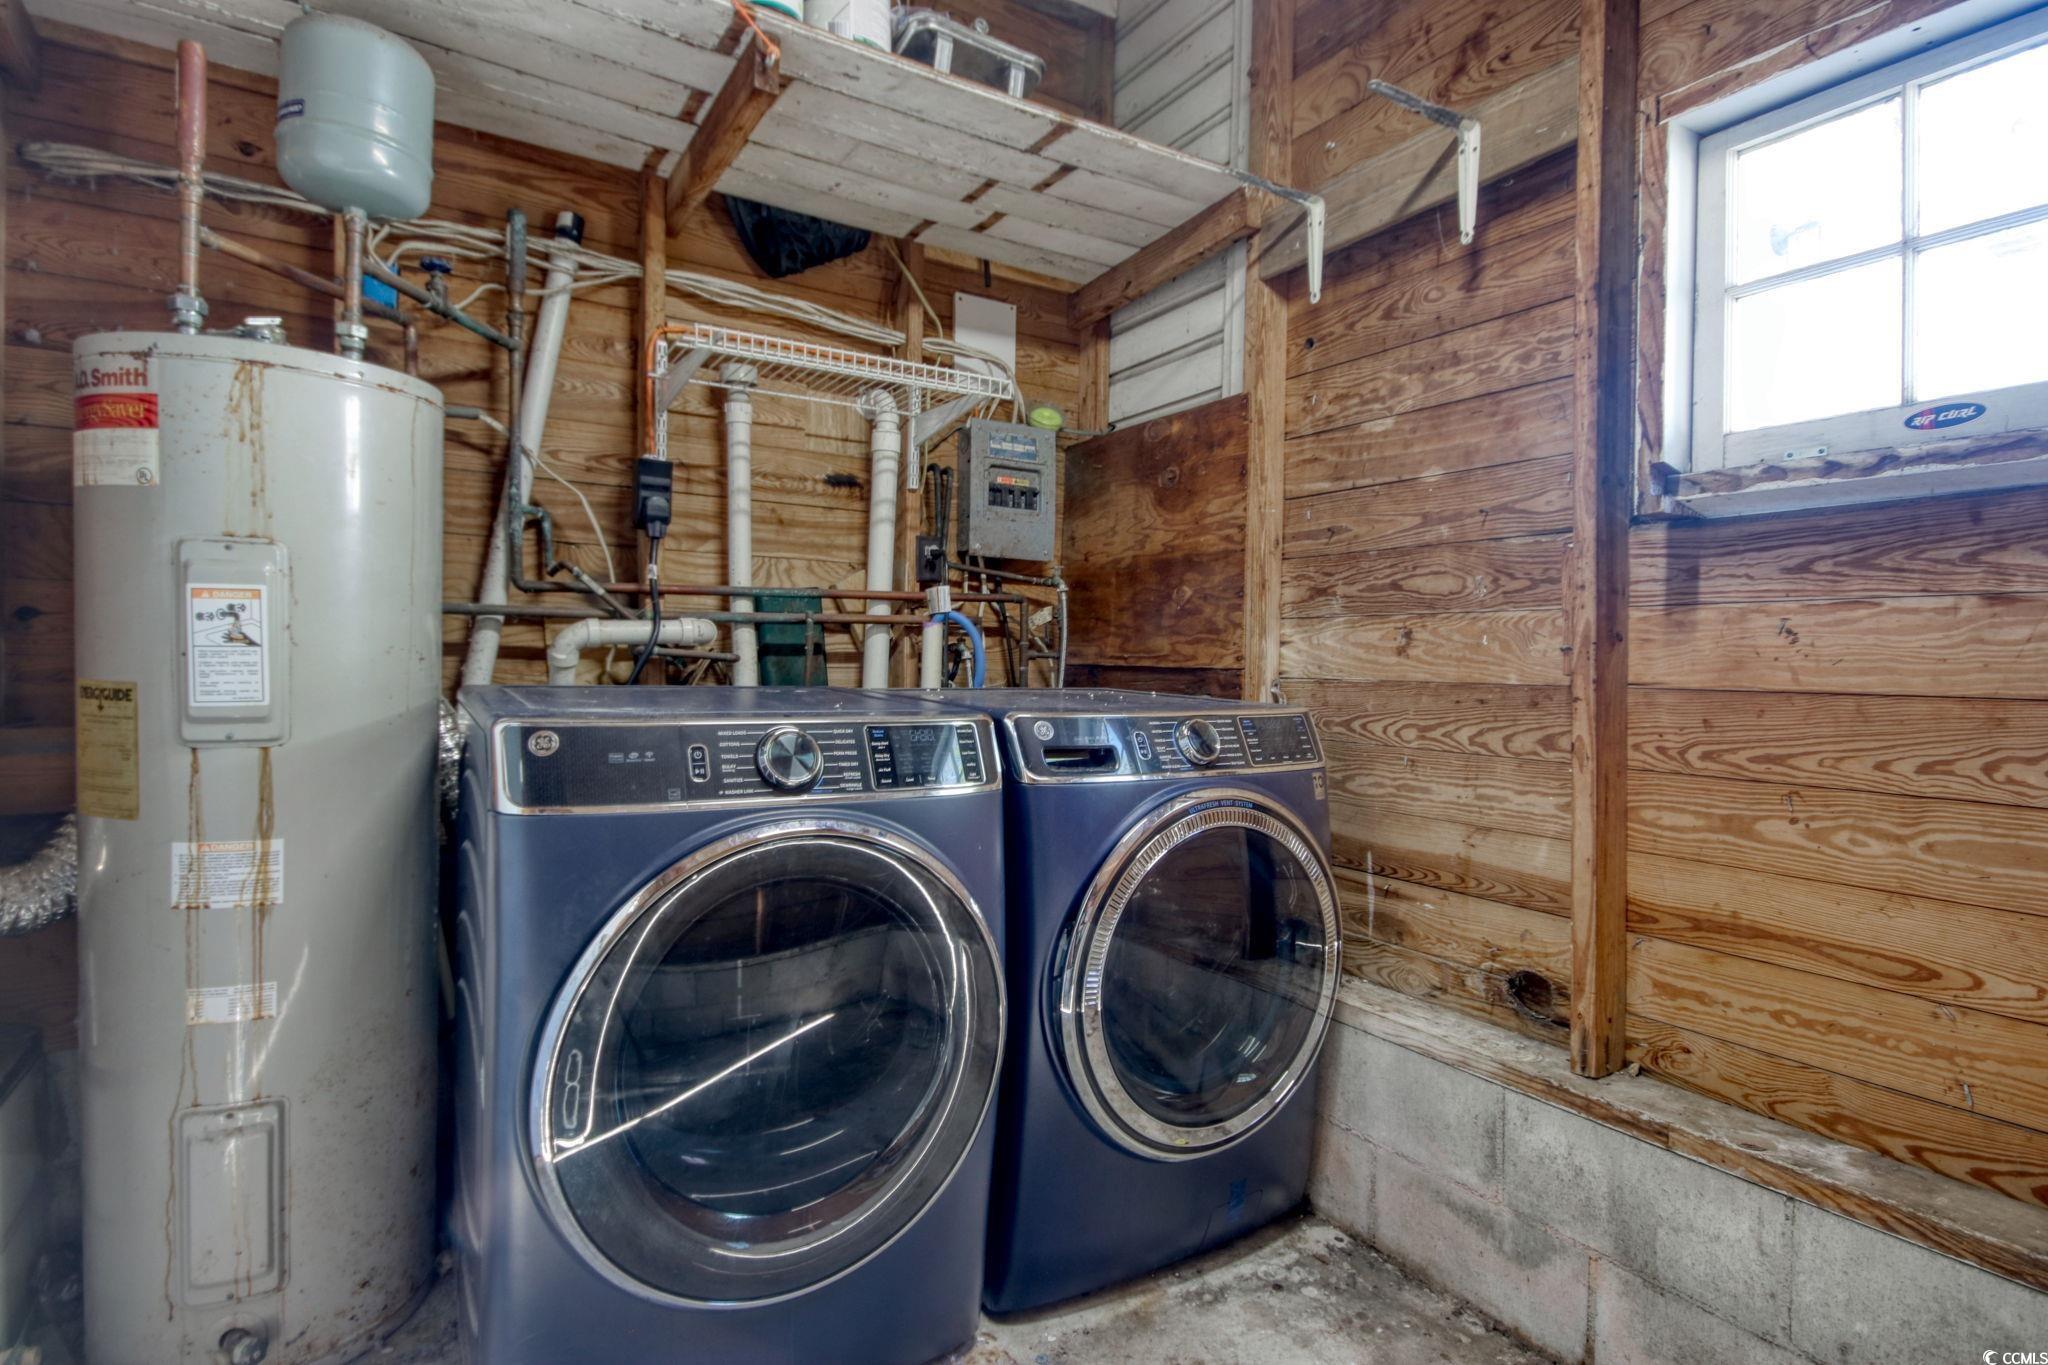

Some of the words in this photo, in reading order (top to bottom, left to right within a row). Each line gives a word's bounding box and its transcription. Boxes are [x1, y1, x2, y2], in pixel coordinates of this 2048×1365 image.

[91, 366, 148, 388] Smith
[1911, 414, 1936, 426] RIP
[1937, 405, 1978, 422] CURL
